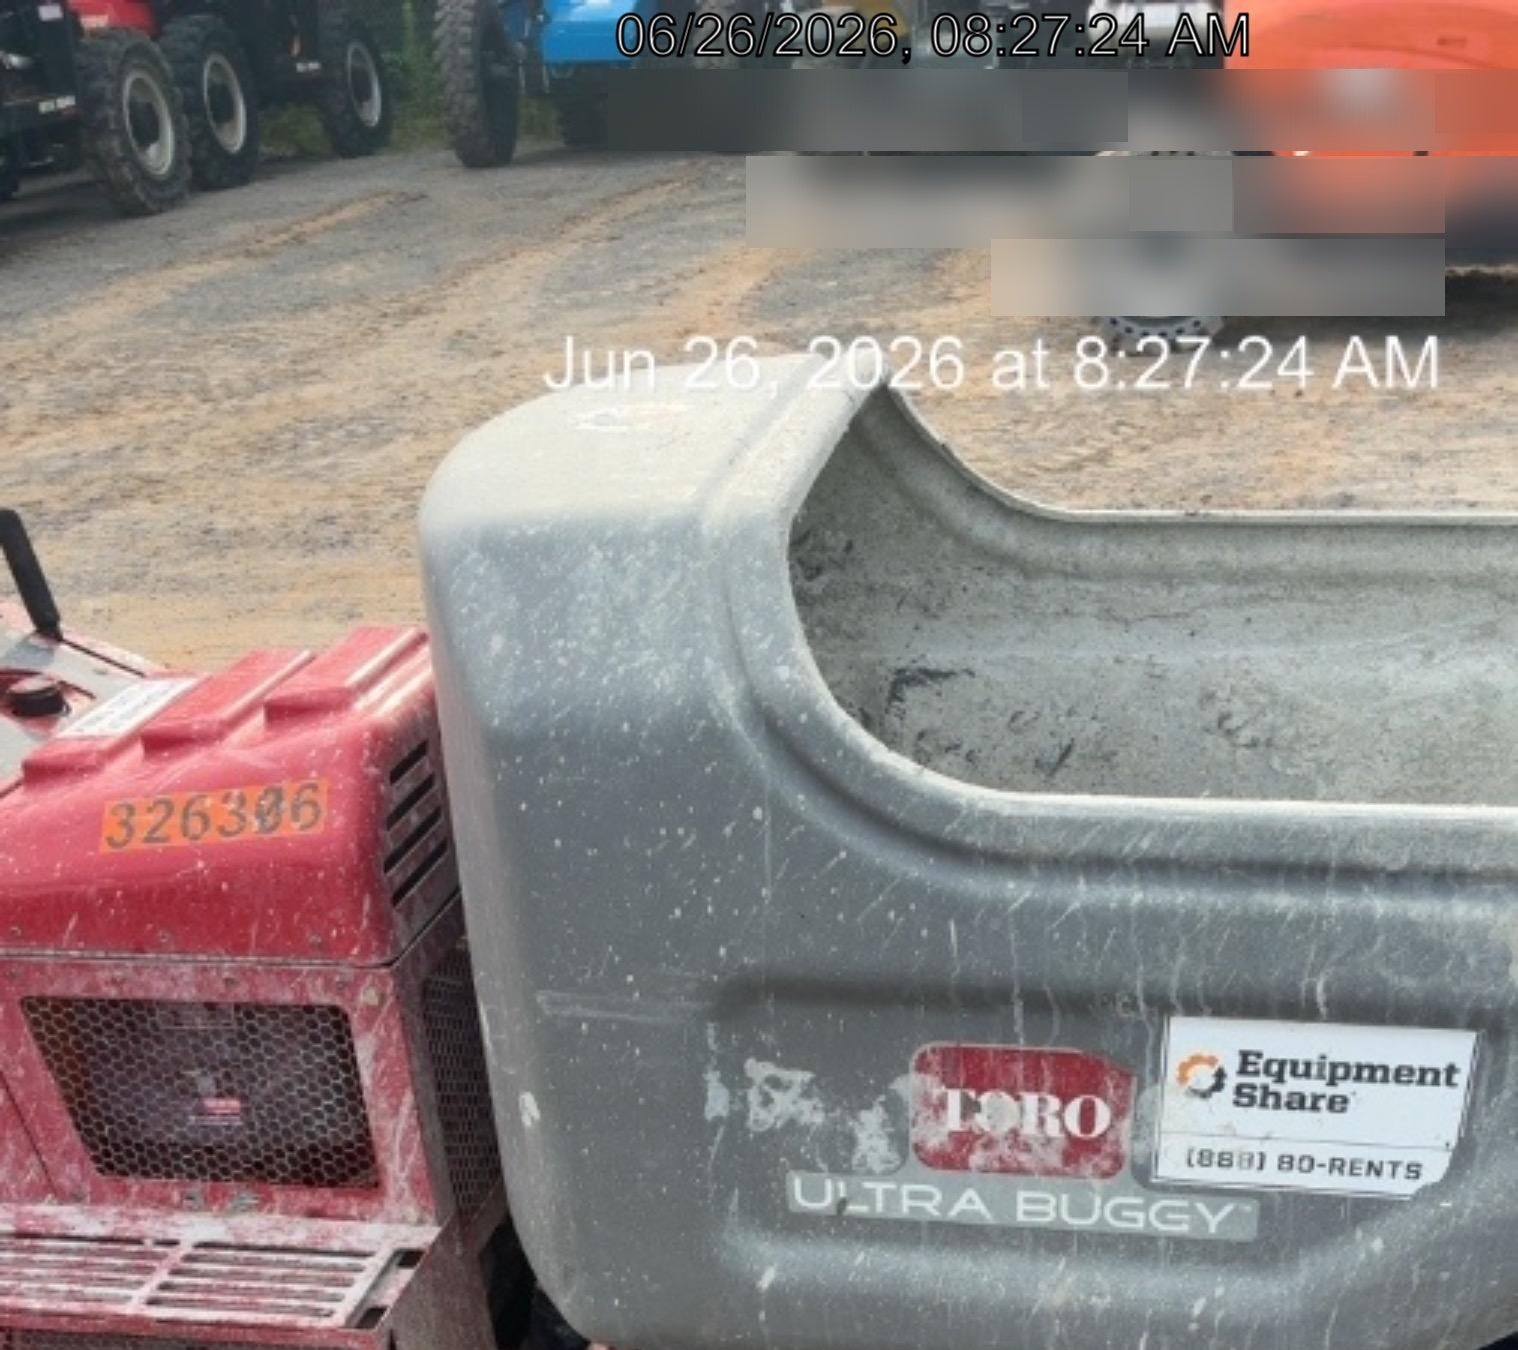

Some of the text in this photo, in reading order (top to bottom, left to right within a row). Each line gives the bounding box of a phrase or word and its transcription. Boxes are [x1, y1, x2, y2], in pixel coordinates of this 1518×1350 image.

[1236, 1049, 1461, 1087] Equipment
[940, 1087, 1112, 1140] TORO
[1232, 1082, 1350, 1114] Share
[1277, 1154, 1424, 1180] 80-RENTS
[792, 1176, 1236, 1236] ULTRA BUGGY
